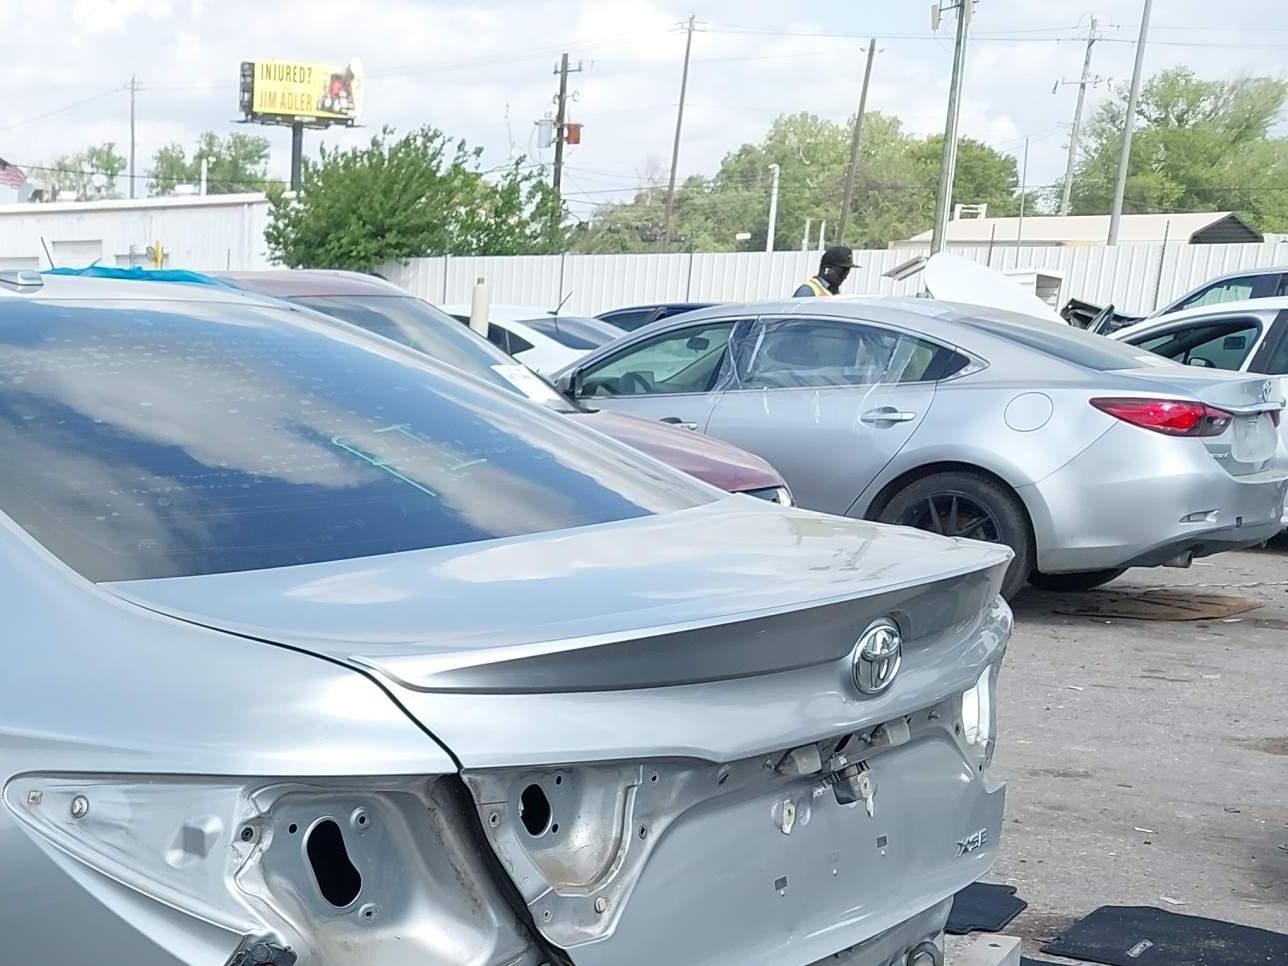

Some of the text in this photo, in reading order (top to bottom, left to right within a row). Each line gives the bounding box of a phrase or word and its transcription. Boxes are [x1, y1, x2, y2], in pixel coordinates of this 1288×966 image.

[259, 91, 312, 112] JIM ADLER
[955, 828, 987, 857] XSE
